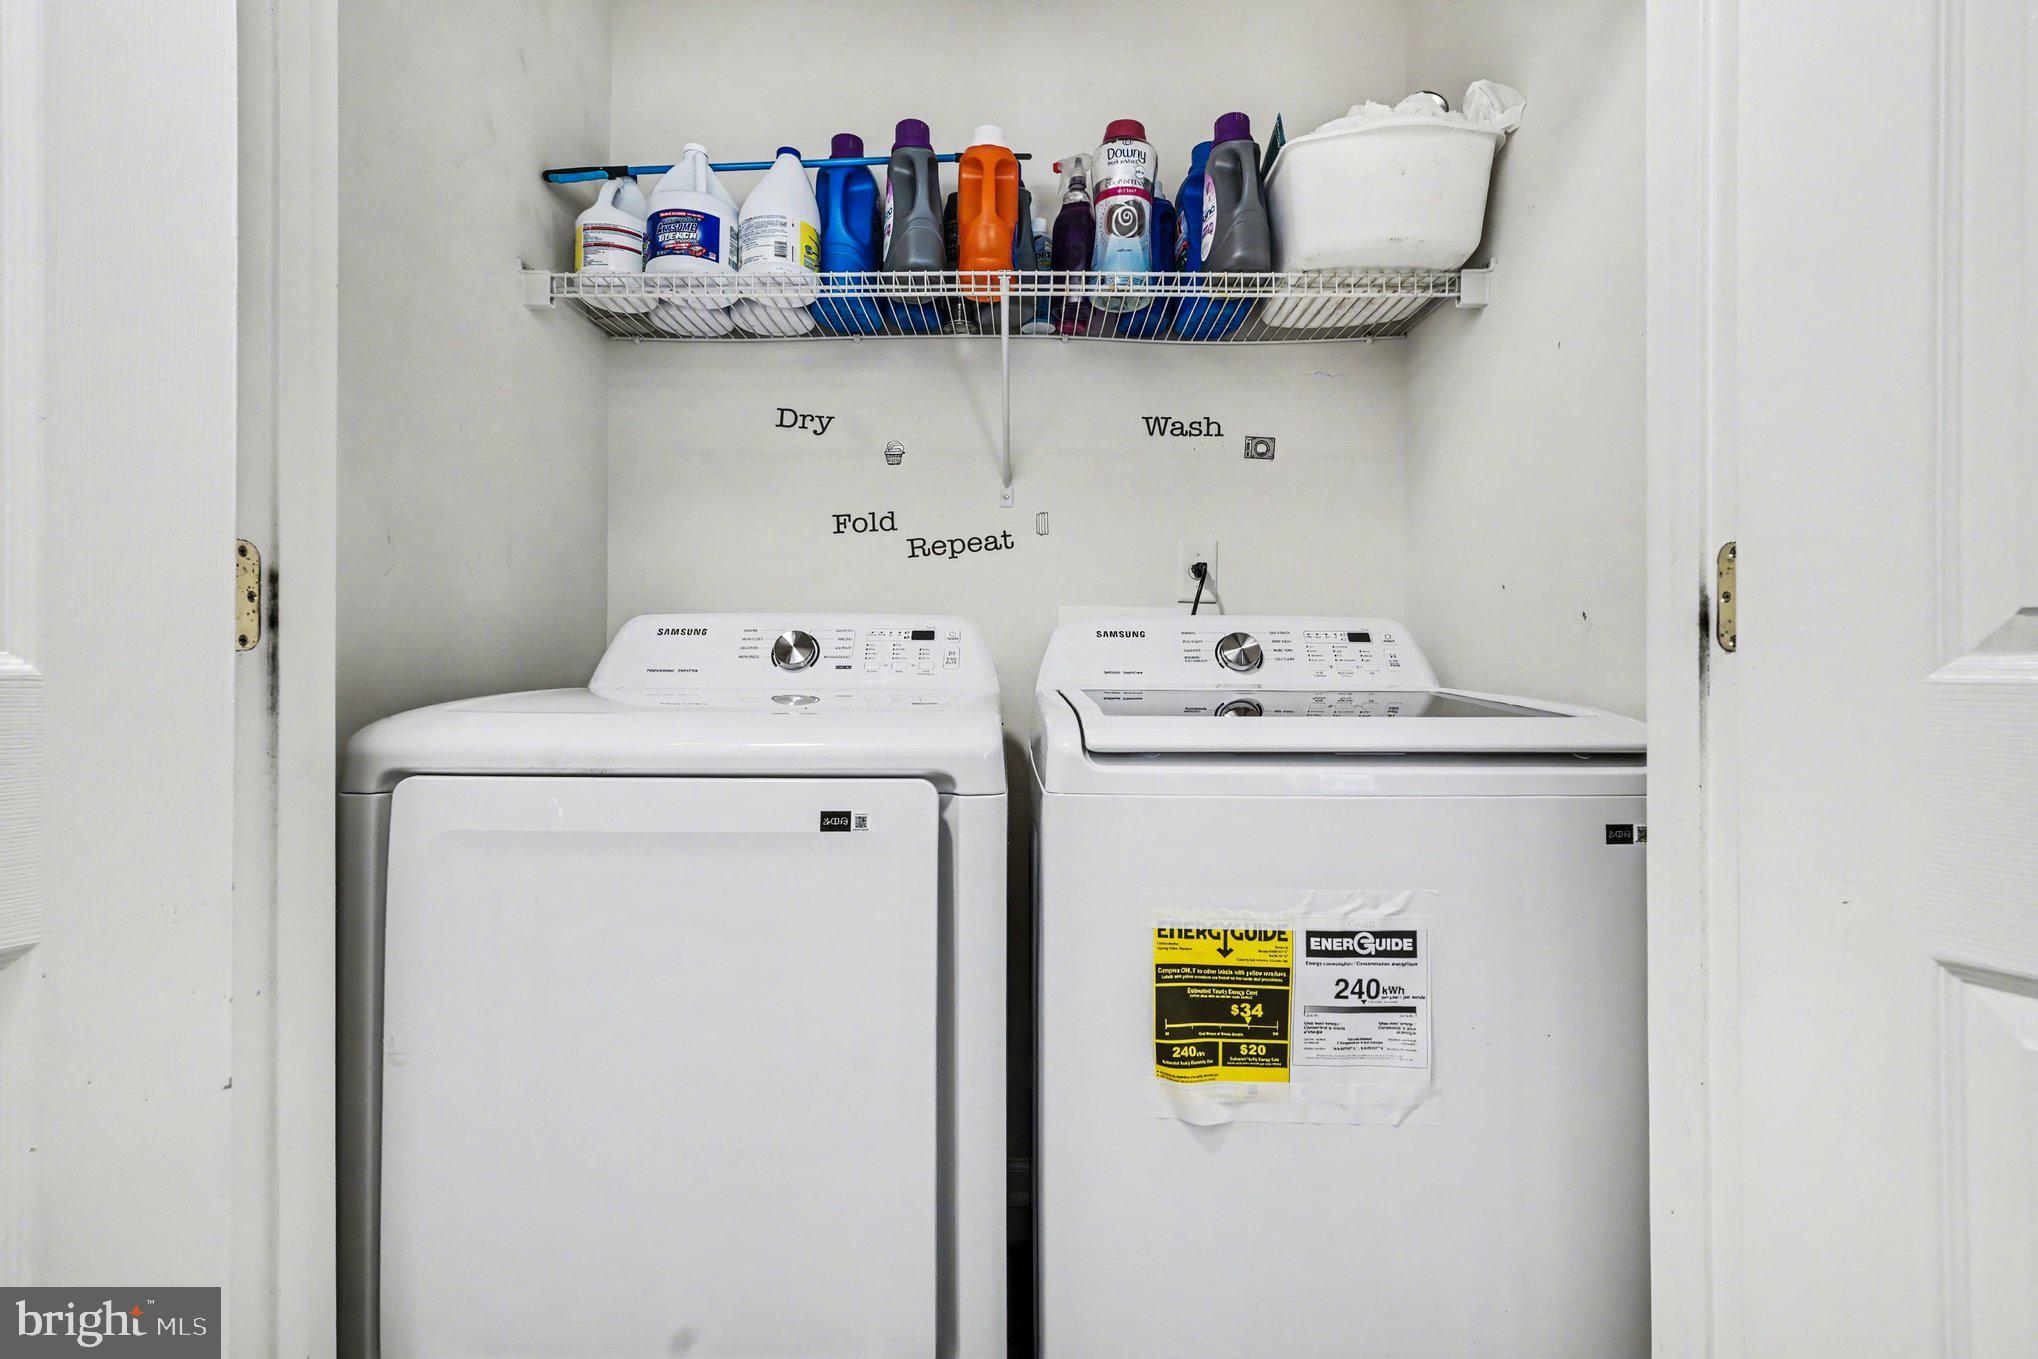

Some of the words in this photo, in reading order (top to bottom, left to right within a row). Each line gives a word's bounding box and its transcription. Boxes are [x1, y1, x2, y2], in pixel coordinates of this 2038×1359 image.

[1107, 147, 1146, 164] Downy
[774, 407, 835, 436] Dry
[1141, 415, 1225, 438] Wash
[831, 511, 898, 535] Fold
[906, 530, 1015, 560] Repeat
[656, 628, 708, 636] SAMSUNG
[1096, 630, 1146, 638] SAMSUNG
[1310, 931, 1413, 955] ENERGUIDE
[1333, 978, 1381, 1000] 240
[1382, 985, 1405, 995] kWh
[1230, 1003, 1264, 1017] $34
[1172, 1045, 1197, 1058] 240
[1240, 1044, 1267, 1056] $20
